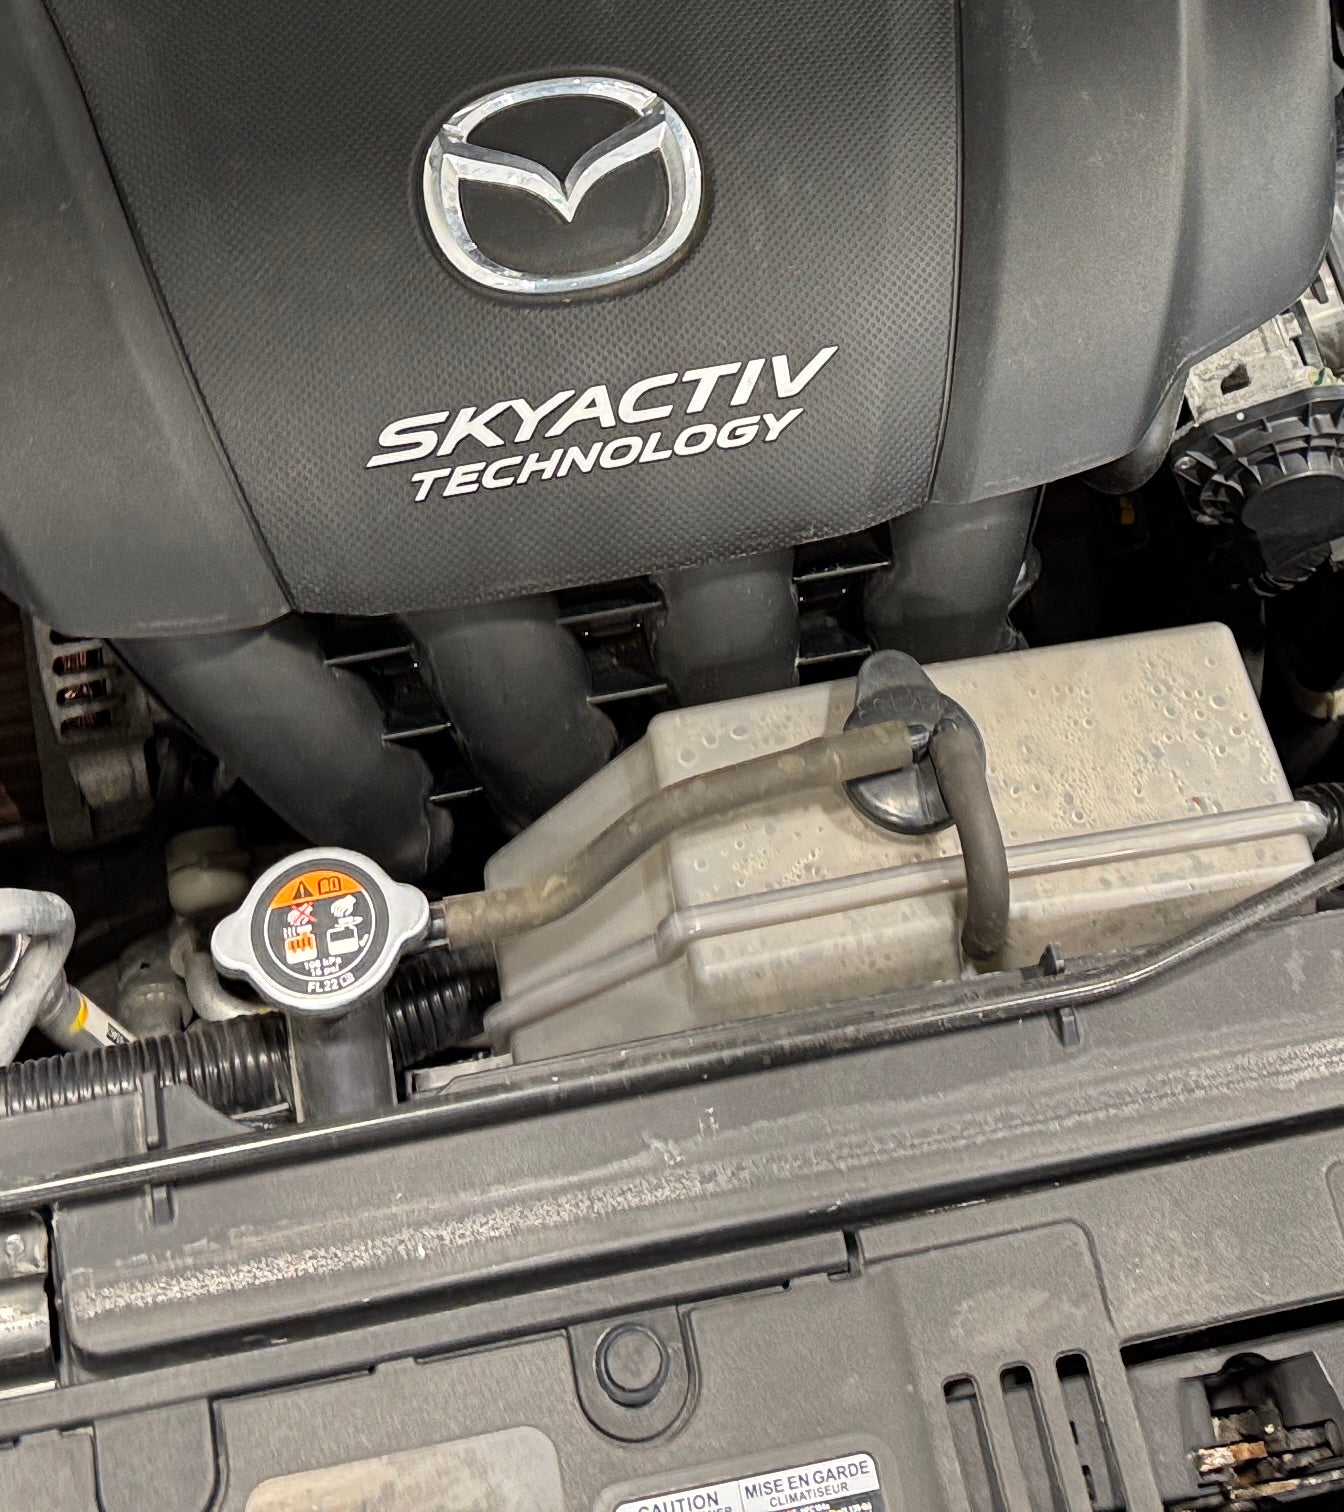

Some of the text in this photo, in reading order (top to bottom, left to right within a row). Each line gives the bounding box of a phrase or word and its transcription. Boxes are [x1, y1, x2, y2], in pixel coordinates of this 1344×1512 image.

[365, 345, 839, 468] SKYACTIV
[410, 407, 805, 503] TECHNOLOGY
[307, 978, 339, 993] FL22
[744, 1460, 871, 1500] MISE EN GARDE
[769, 1482, 850, 1508] CLIMATISEUR
